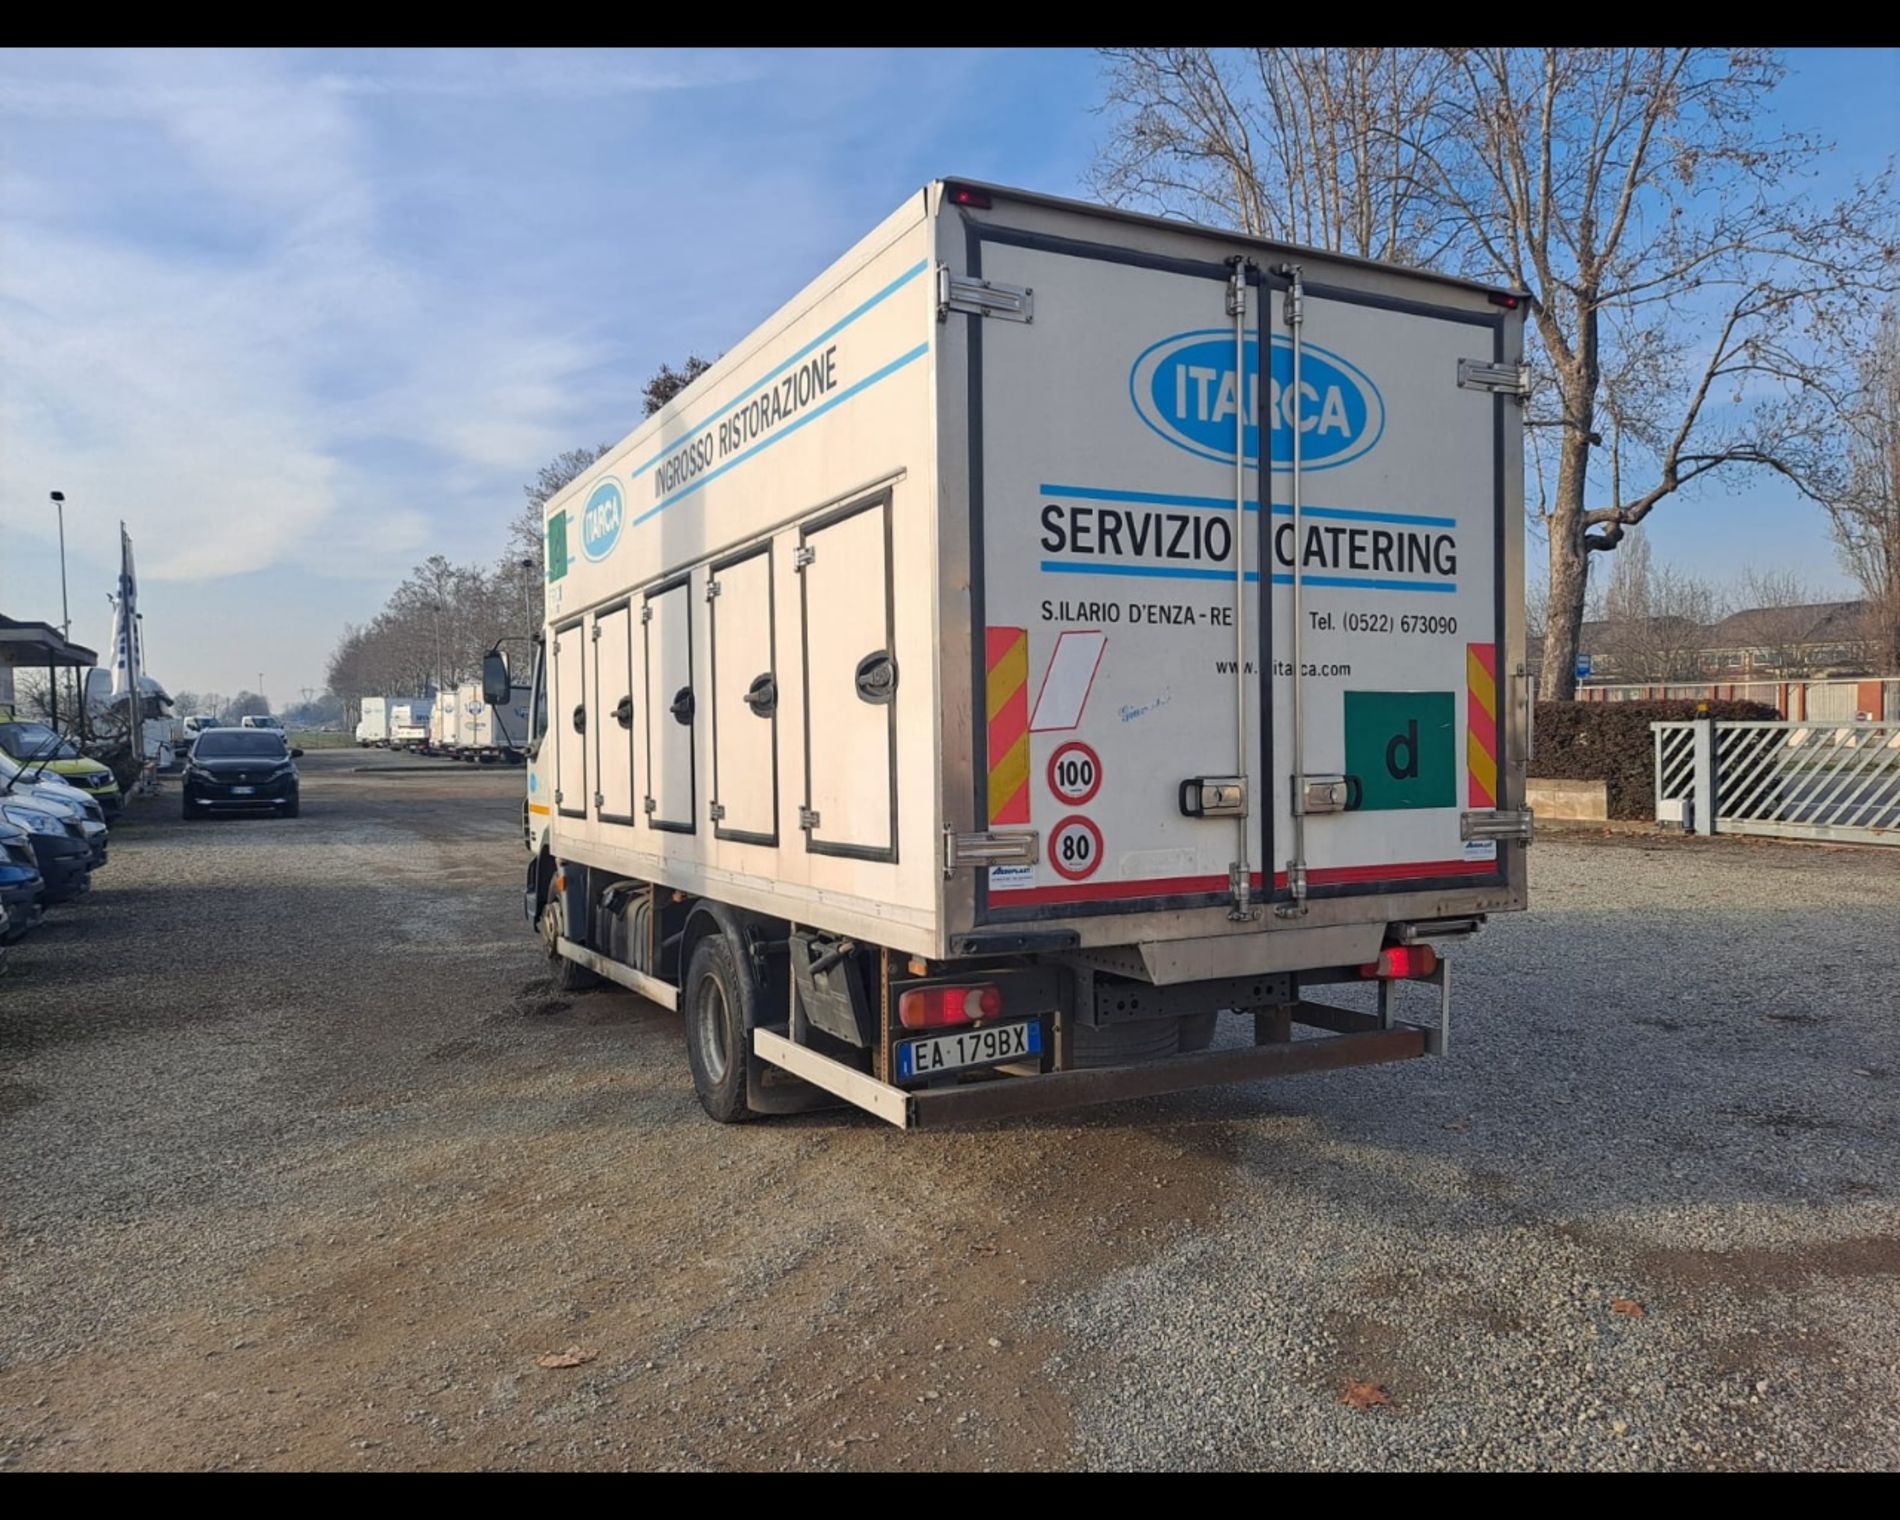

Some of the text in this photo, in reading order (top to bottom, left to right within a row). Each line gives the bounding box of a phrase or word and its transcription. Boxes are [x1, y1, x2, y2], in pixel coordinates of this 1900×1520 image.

[655, 345, 837, 498] INGROSSO RISTORAZIONE
[1176, 363, 1352, 438] ITARCA
[1041, 504, 1457, 576] SERVIZIO CATERING
[1041, 600, 1121, 623] S.ILARIO
[1309, 611, 1457, 635] Tel. (0522) 673090
[1386, 719, 1418, 780] d
[1058, 760, 1093, 786] 100
[1062, 835, 1090, 861] 80
